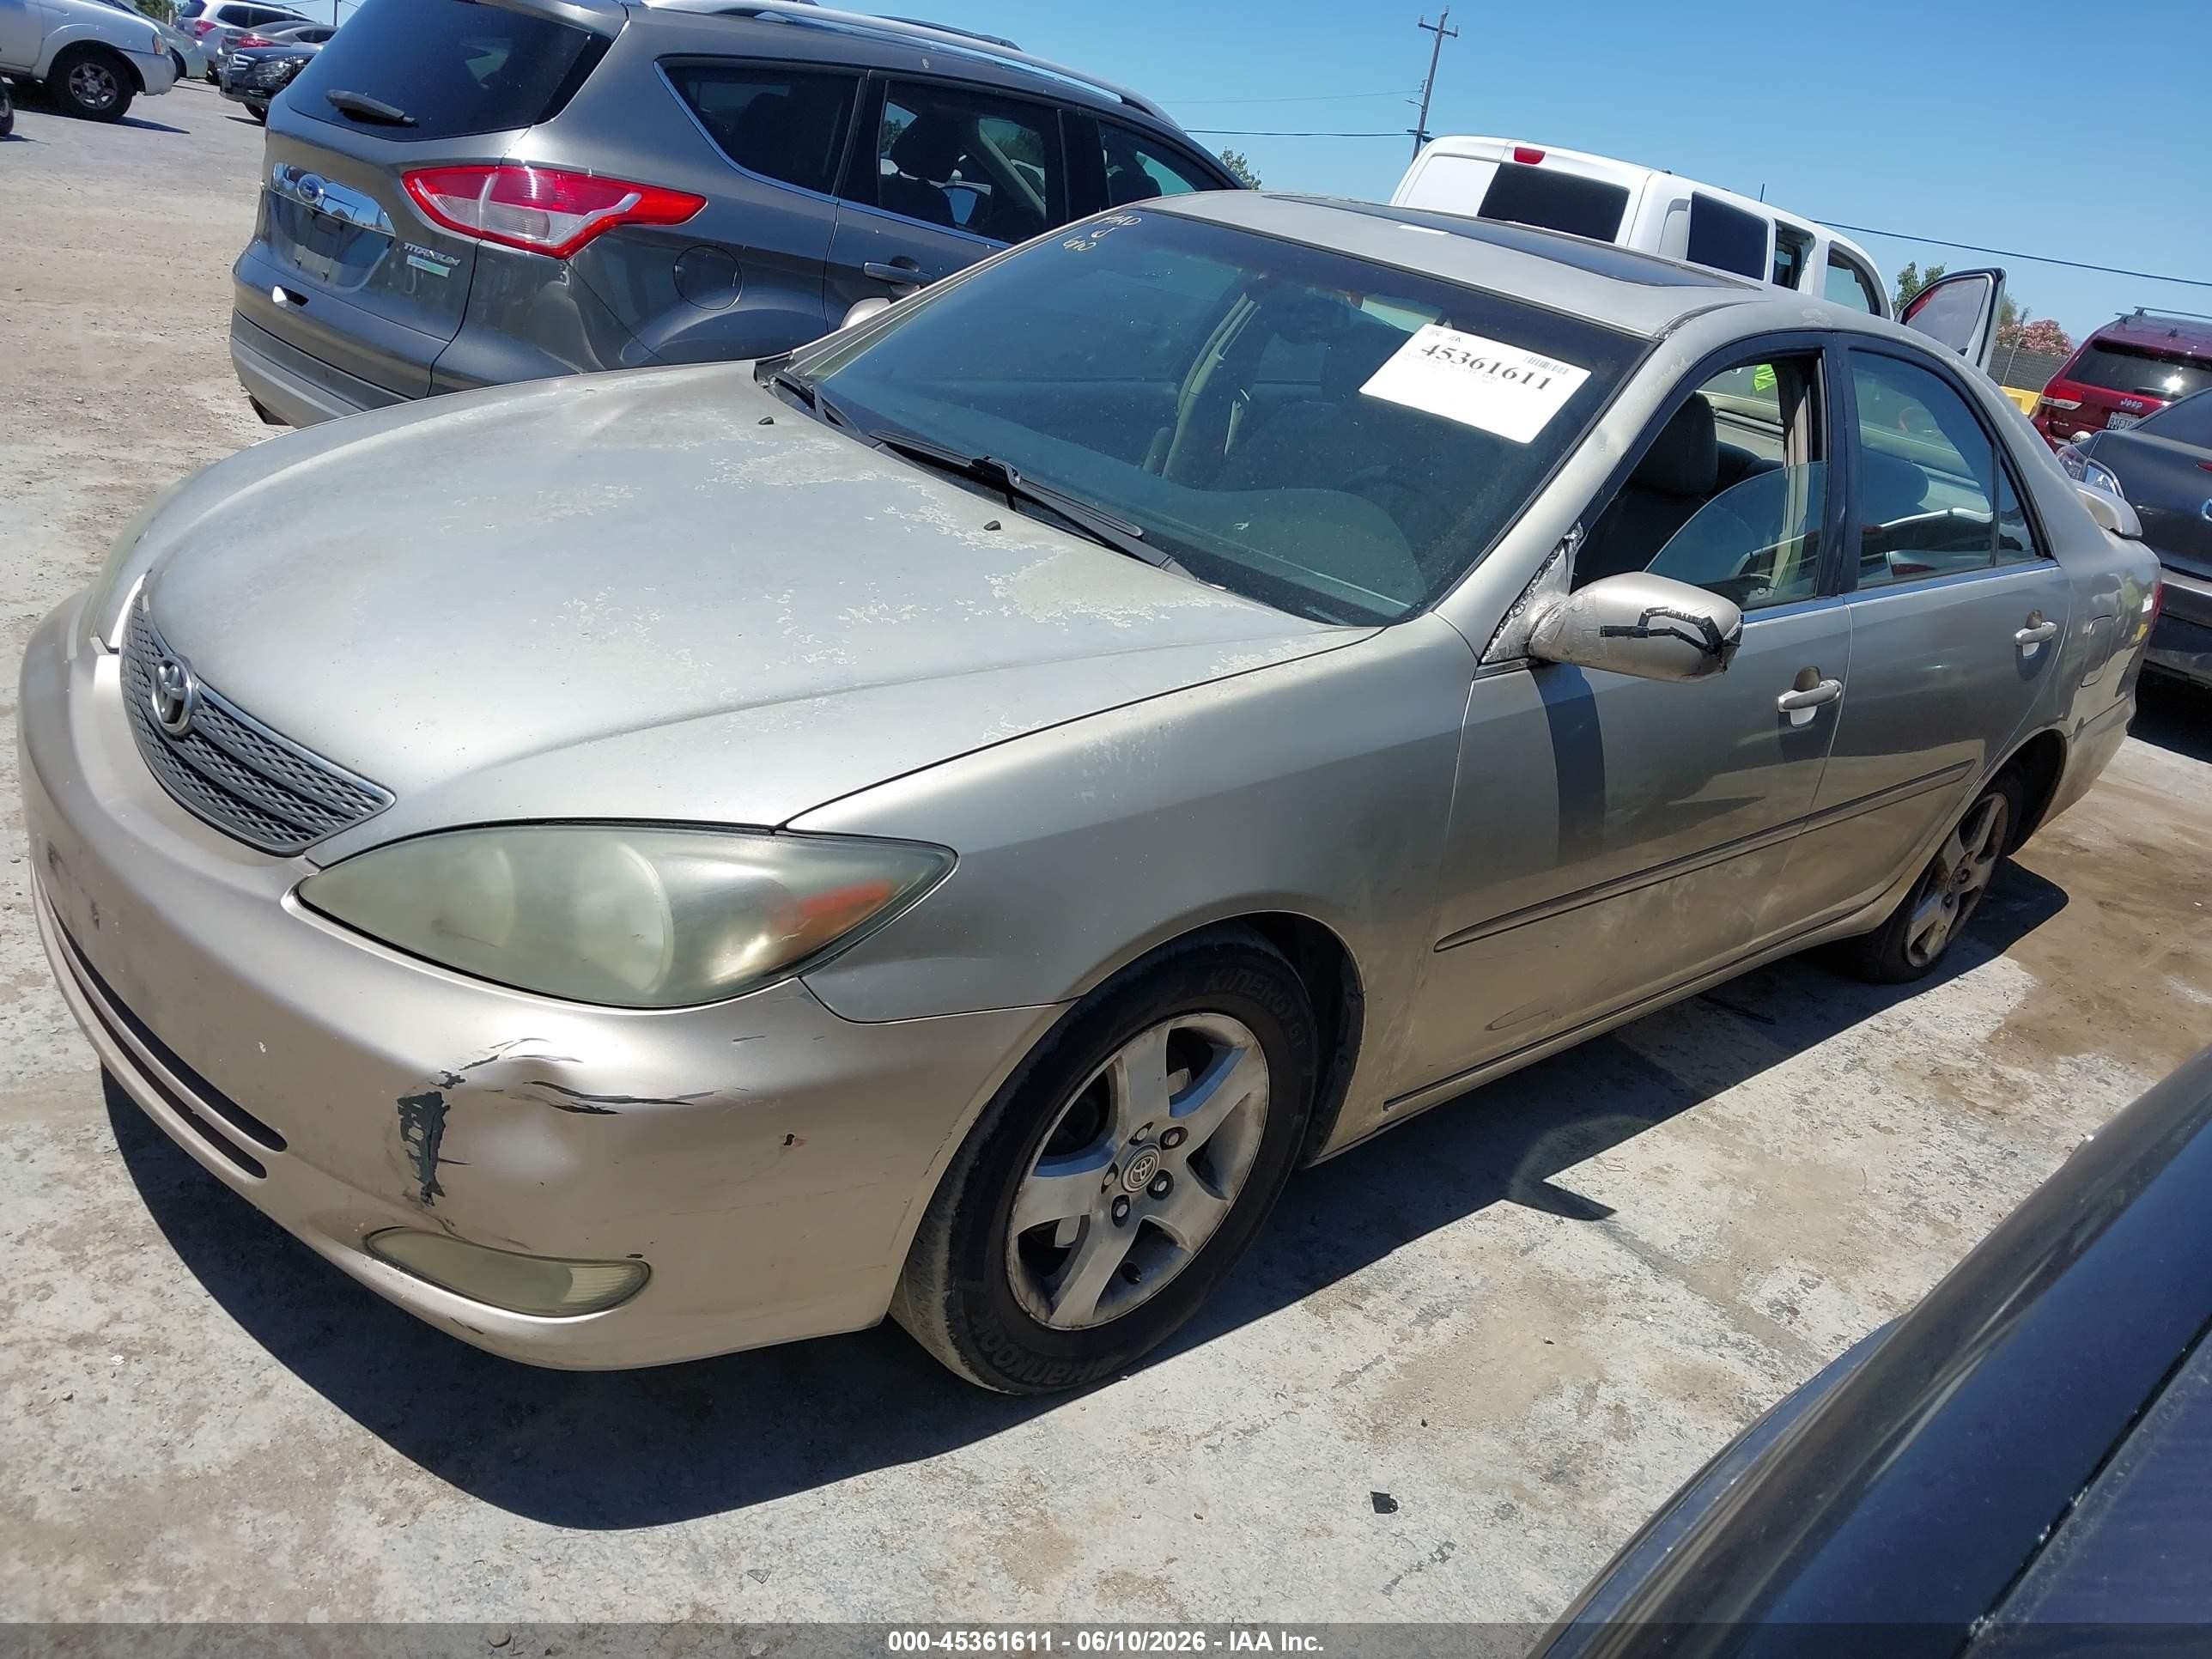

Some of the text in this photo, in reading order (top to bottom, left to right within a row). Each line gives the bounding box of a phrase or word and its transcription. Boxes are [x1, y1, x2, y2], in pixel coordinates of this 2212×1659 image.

[404, 241, 461, 266] TITANIUM
[1421, 343, 1553, 391] 45361611
[2120, 398, 2142, 409] Jeep
